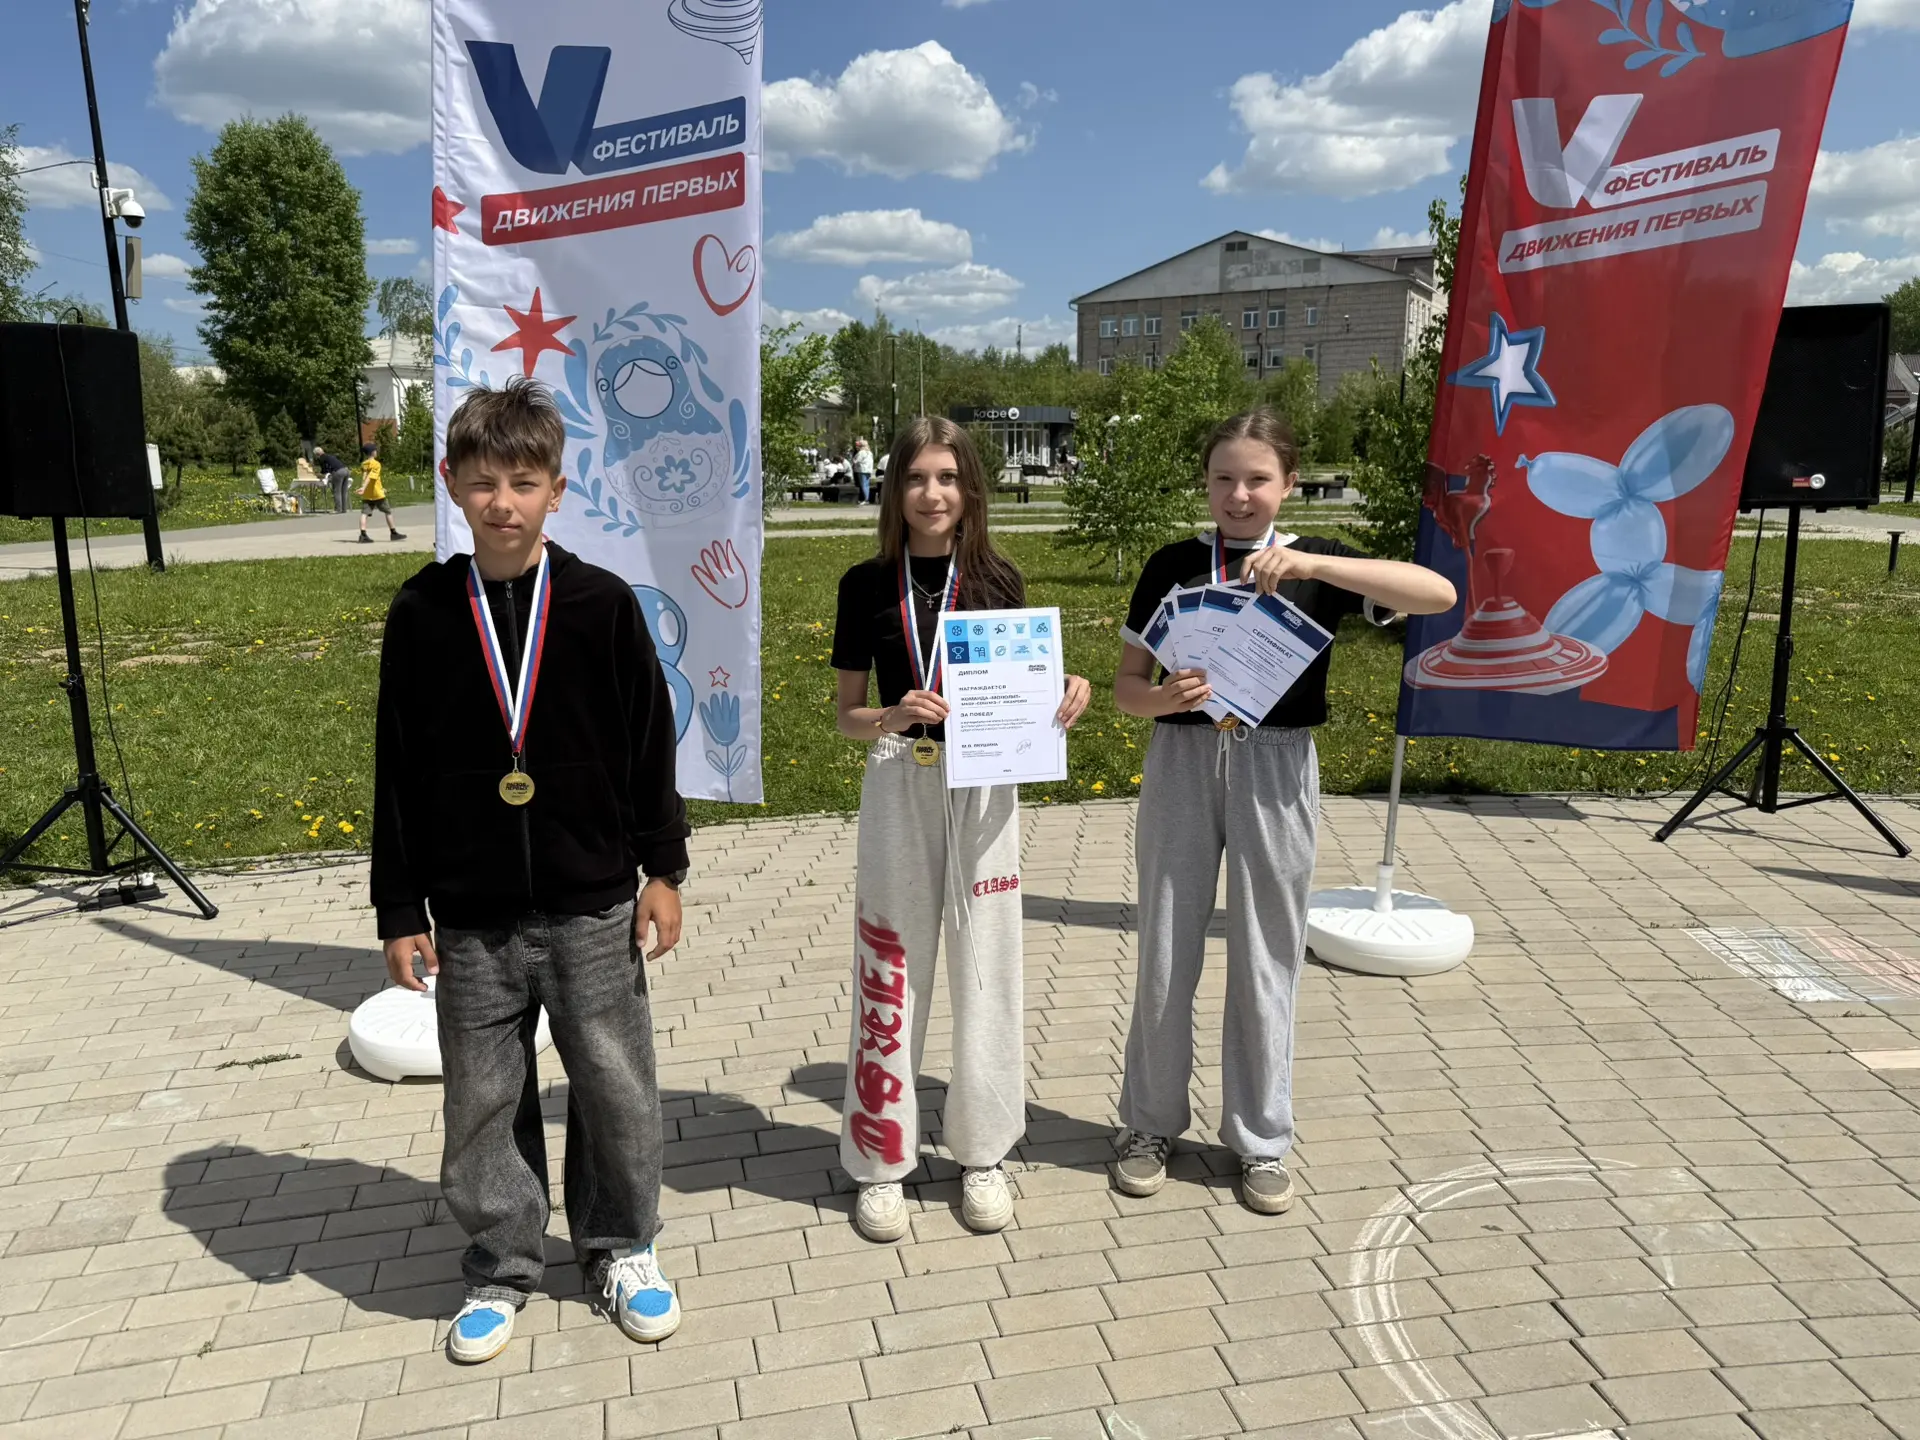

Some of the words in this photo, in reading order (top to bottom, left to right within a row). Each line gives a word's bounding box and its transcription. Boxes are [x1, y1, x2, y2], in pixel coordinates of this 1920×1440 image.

[592, 113, 740, 162] ФЕСТИВАЛЬ
[1604, 145, 1768, 195] ФЕСТИВАЛЬ
[492, 189, 635, 233] ДВИЖЕНИЯ
[641, 168, 739, 207] ПЕРВЫХ
[1505, 219, 1639, 263] ДВИЖЕНИЯ
[1643, 194, 1759, 234] ПЕРВЫХ
[1252, 628, 1293, 658] СЕРТИФИКАТ
[972, 874, 1020, 898] CLASS
